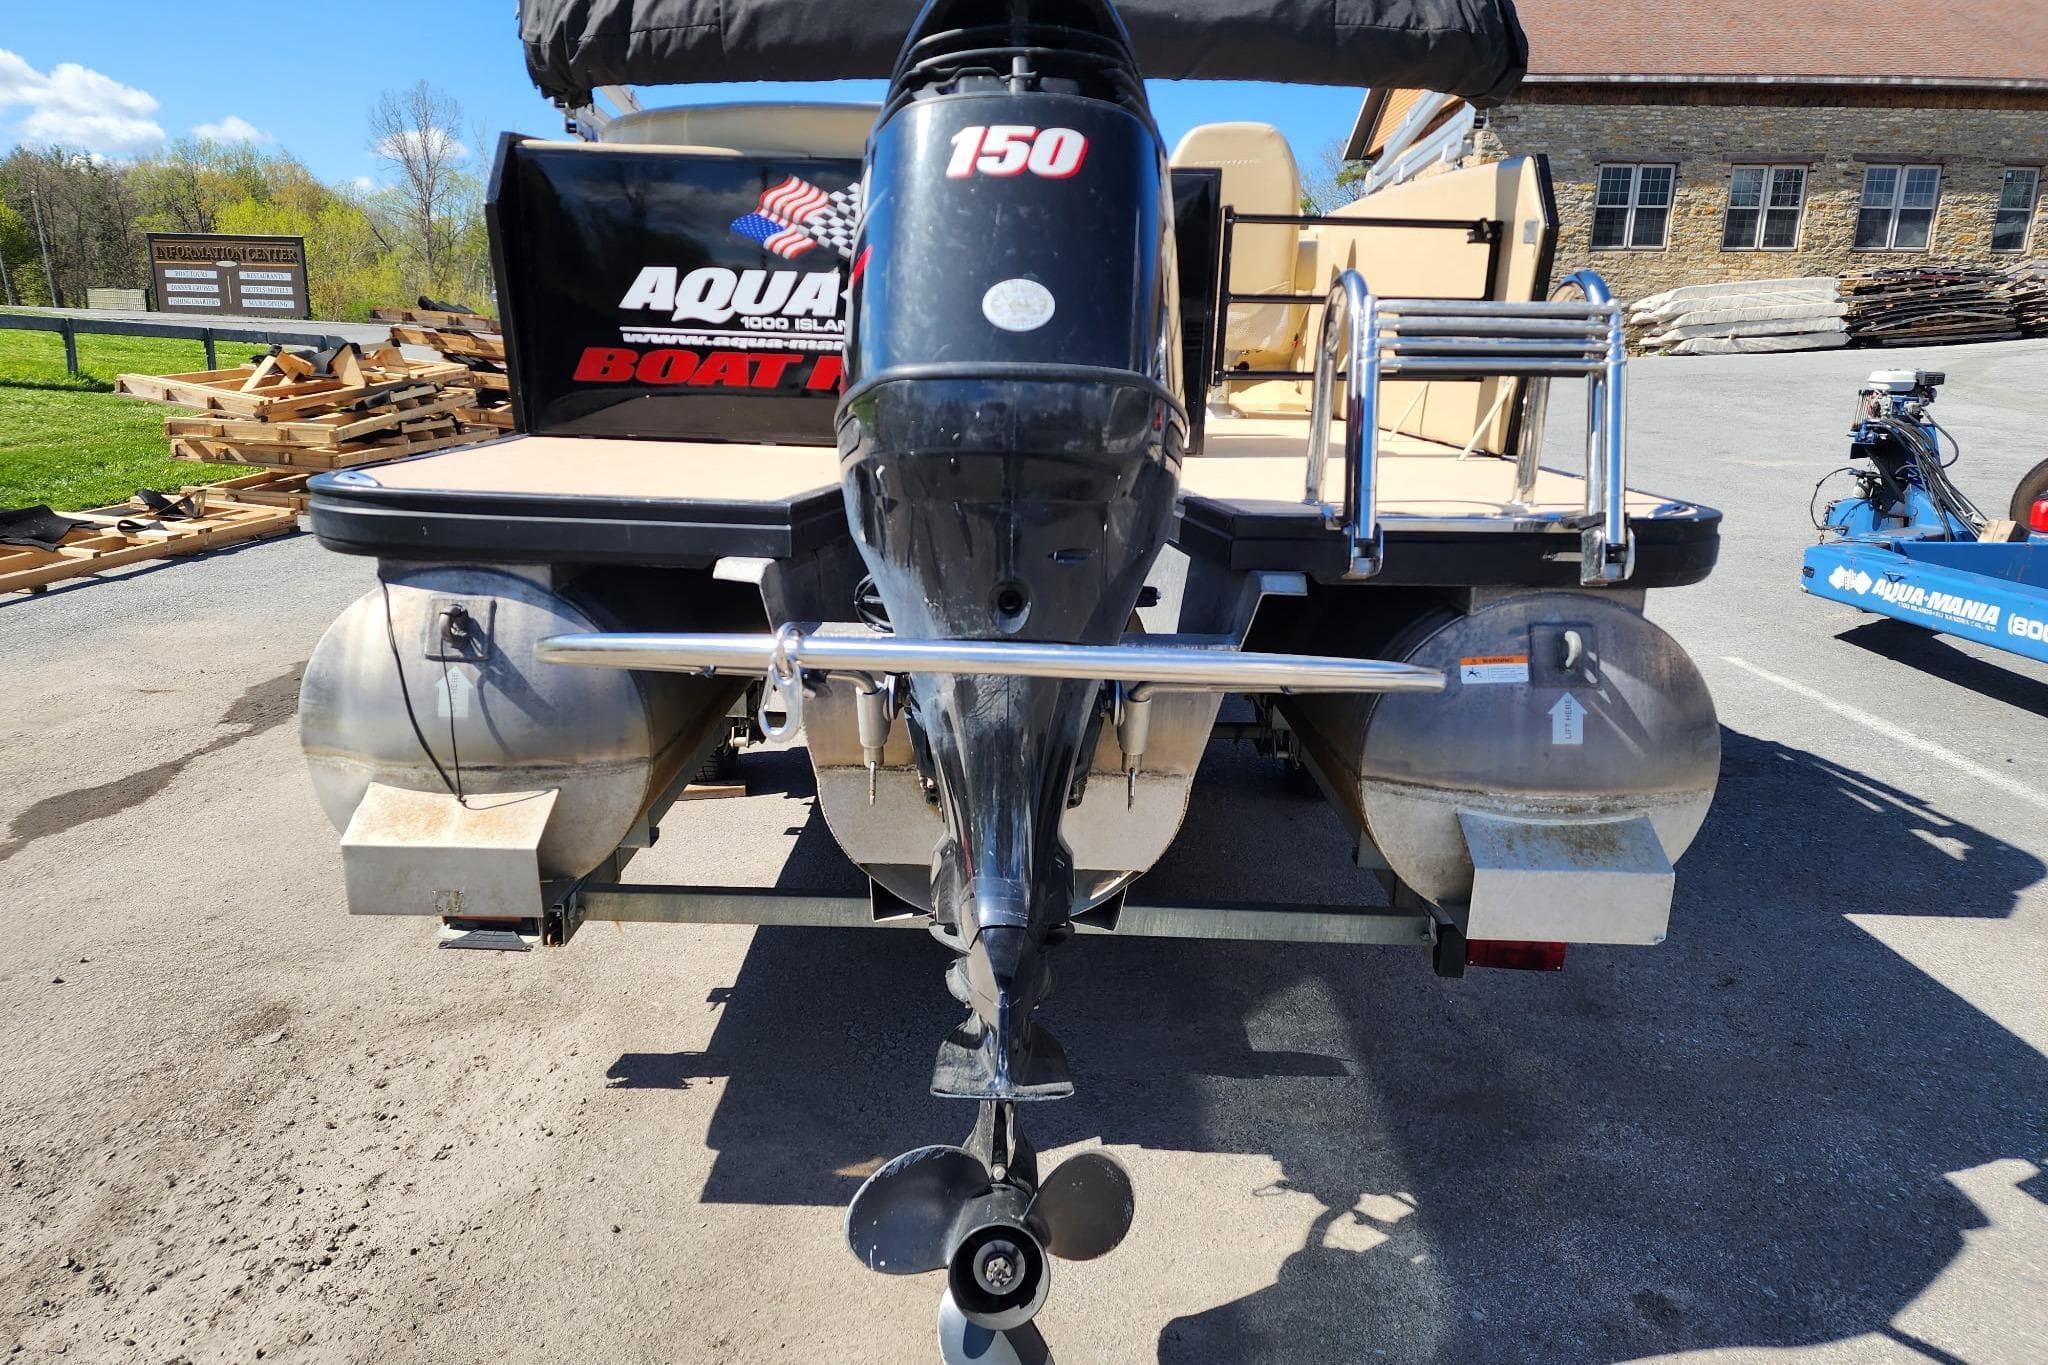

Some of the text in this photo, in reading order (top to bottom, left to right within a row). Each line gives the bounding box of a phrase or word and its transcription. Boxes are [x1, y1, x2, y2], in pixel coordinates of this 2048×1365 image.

[945, 125, 1089, 180] 150
[154, 245, 298, 261] INFORMATION CENTER
[246, 272, 285, 280] RESTAURANTS
[618, 266, 841, 325] AQUA
[740, 316, 789, 331] 1000
[572, 347, 805, 389] BOAT
